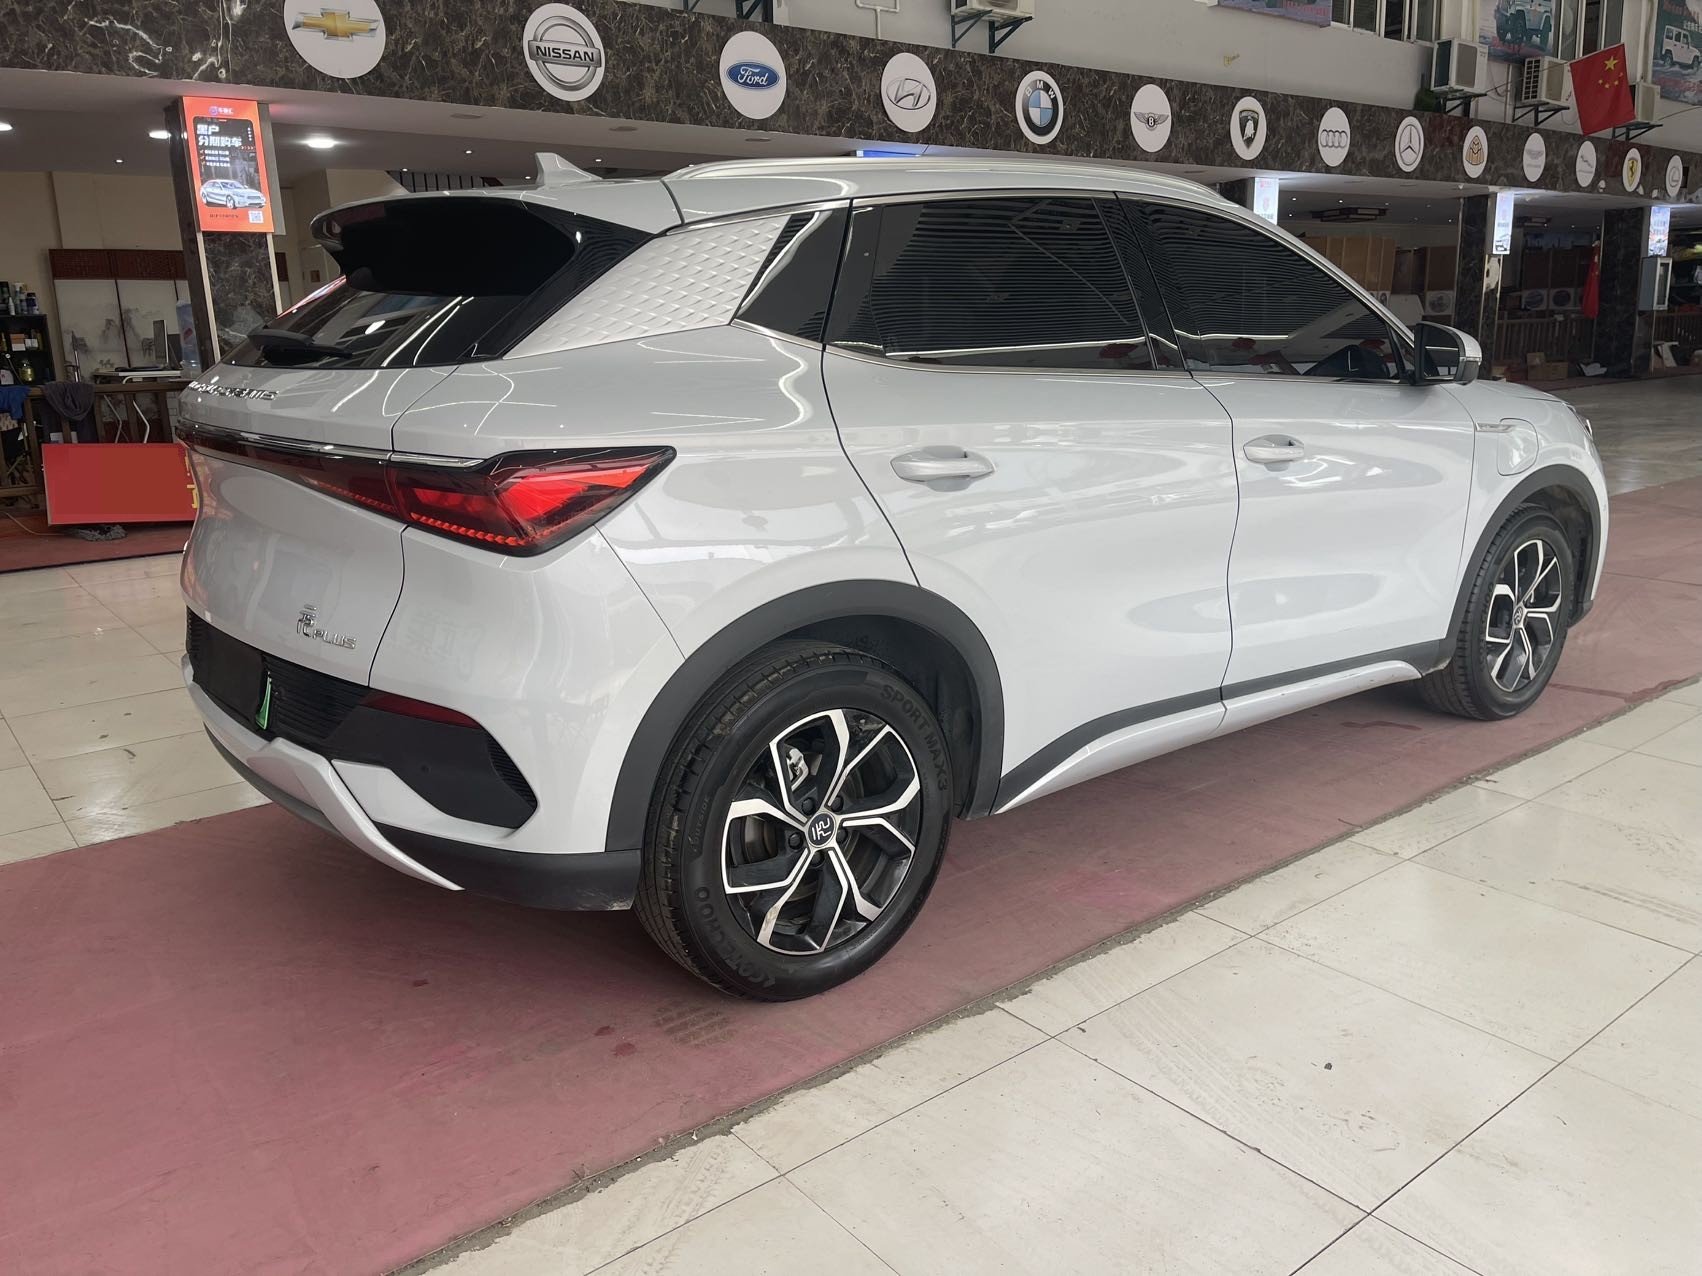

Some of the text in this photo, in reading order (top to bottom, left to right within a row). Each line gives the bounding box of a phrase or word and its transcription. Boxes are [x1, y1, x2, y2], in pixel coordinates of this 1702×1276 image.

[535, 45, 595, 62] NISSAN
[737, 66, 769, 85] Ford
[1025, 80, 1056, 99] BMW
[198, 136, 242, 148] 分期购车
[313, 629, 356, 649] PLUS
[880, 683, 949, 791] SPORT MAX3
